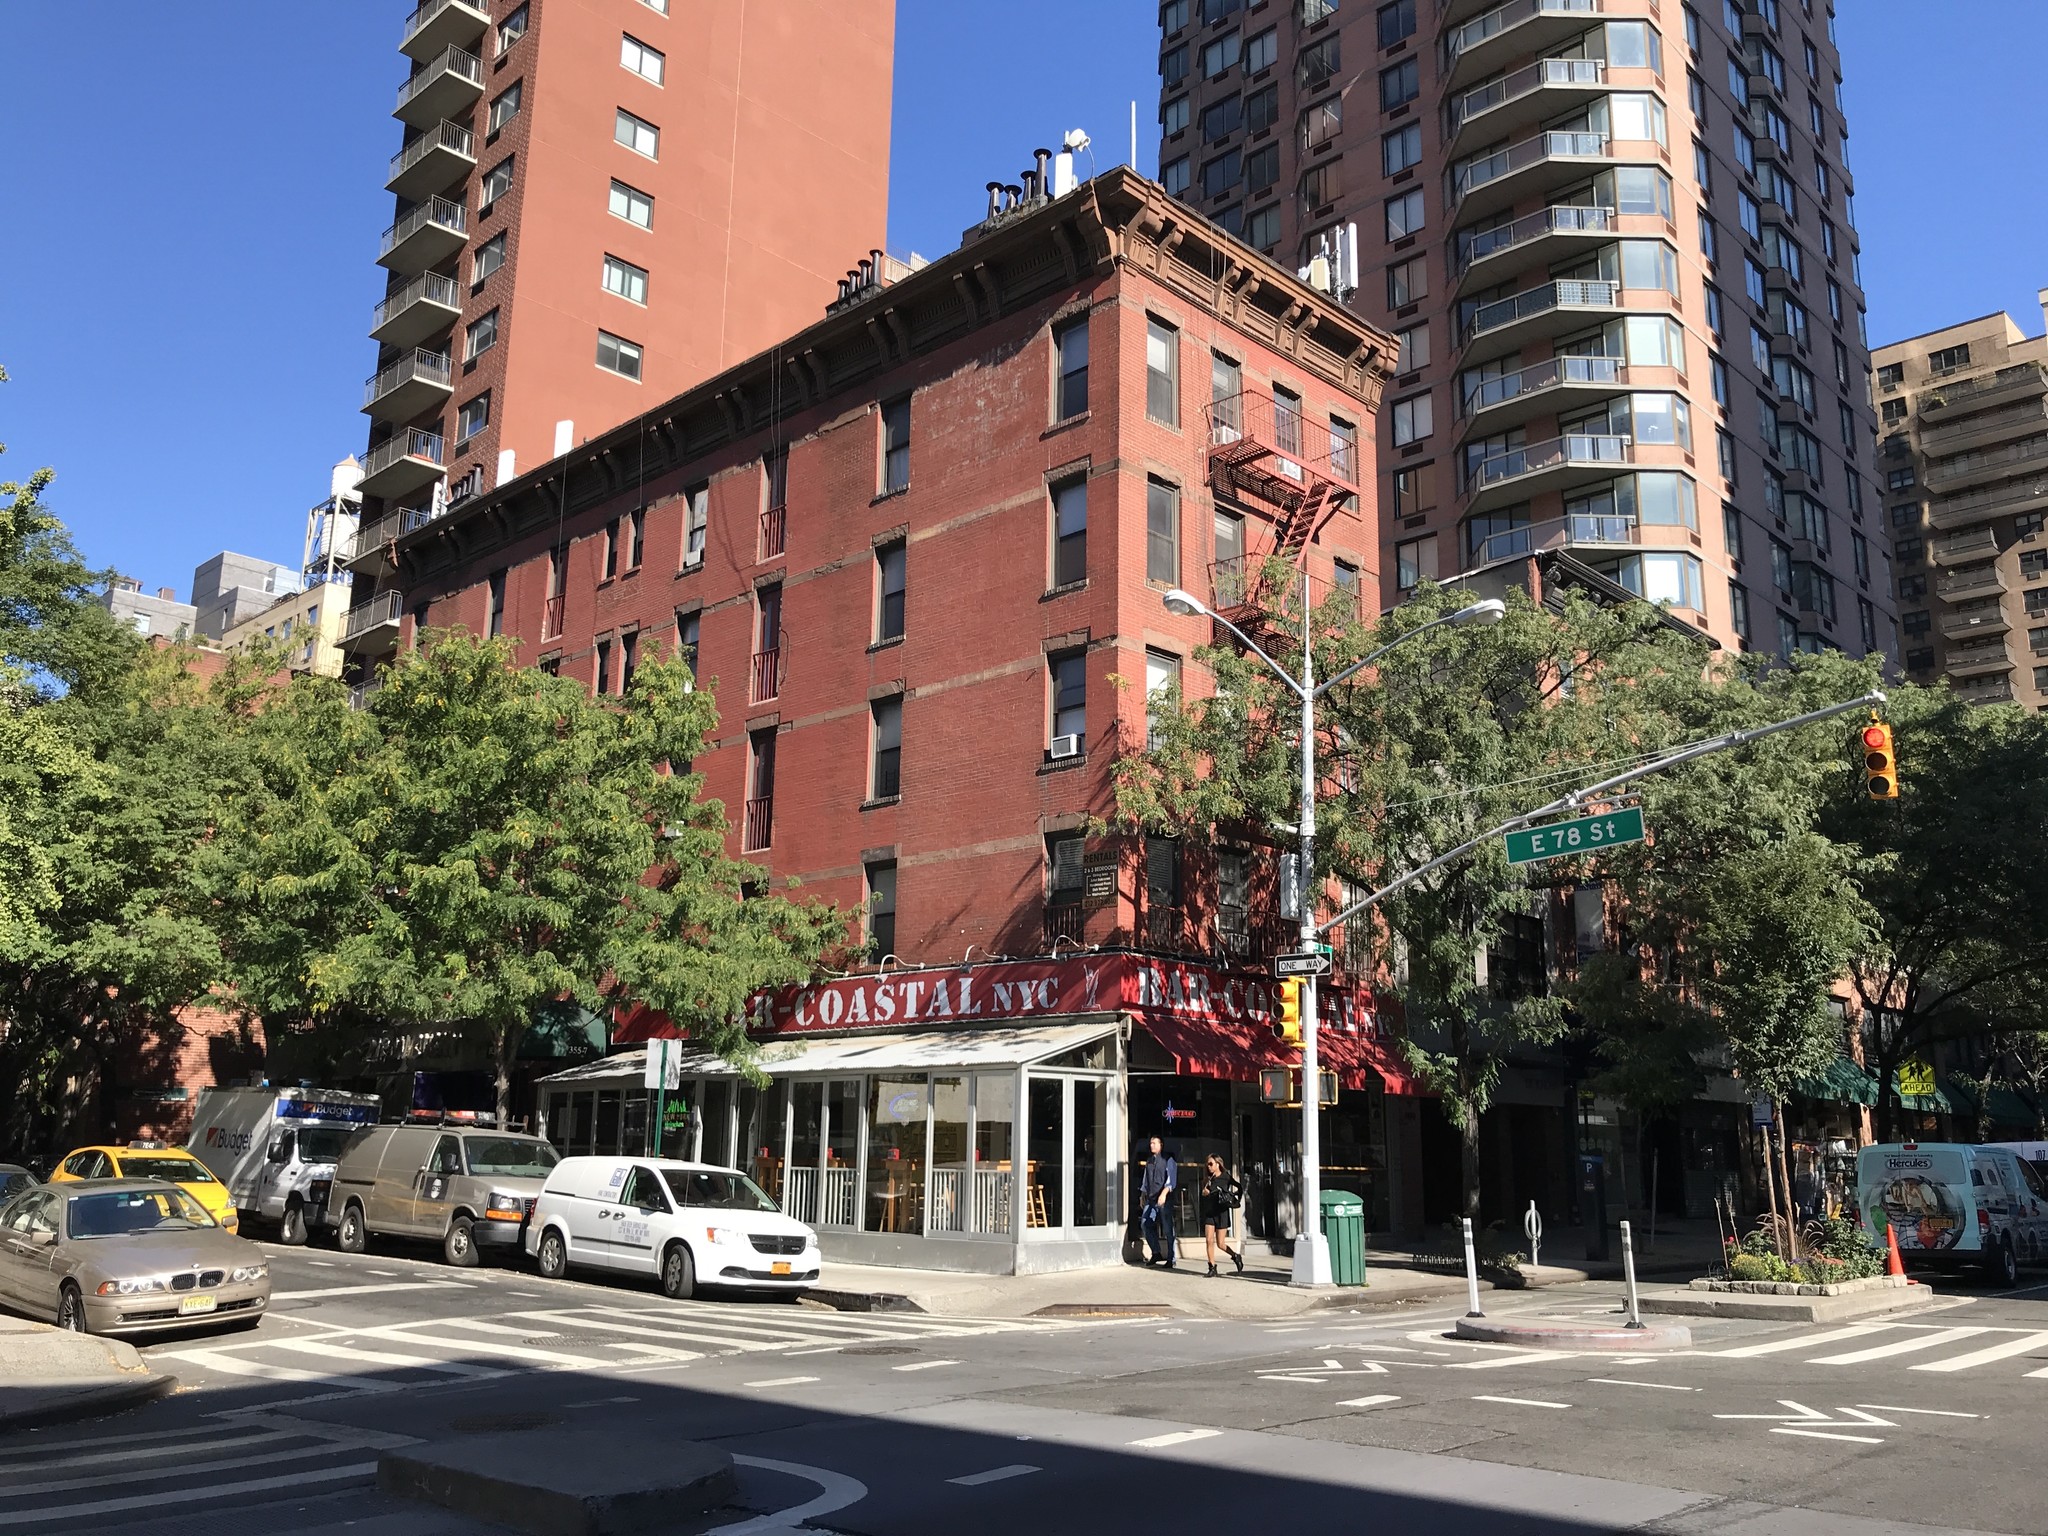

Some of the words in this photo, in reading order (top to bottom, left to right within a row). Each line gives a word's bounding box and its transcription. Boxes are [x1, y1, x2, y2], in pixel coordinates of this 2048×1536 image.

[1531, 834, 1546, 853] E
[1551, 827, 1581, 849] 78
[1590, 820, 1616, 842] St
[1084, 851, 1118, 863] RENTALS
[1280, 962, 1297, 971] ONE
[1305, 960, 1323, 969] WAY
[706, 976, 982, 1032] R-COASTAL
[991, 977, 1059, 1012] NYC
[1904, 1083, 1932, 1092] AHEAD
[317, 1103, 353, 1118] Budget
[217, 1128, 253, 1156] Budget
[2035, 1149, 2046, 1161] 107
[1586, 1163, 1593, 1173] P
[1889, 1158, 1928, 1168] Hercules
